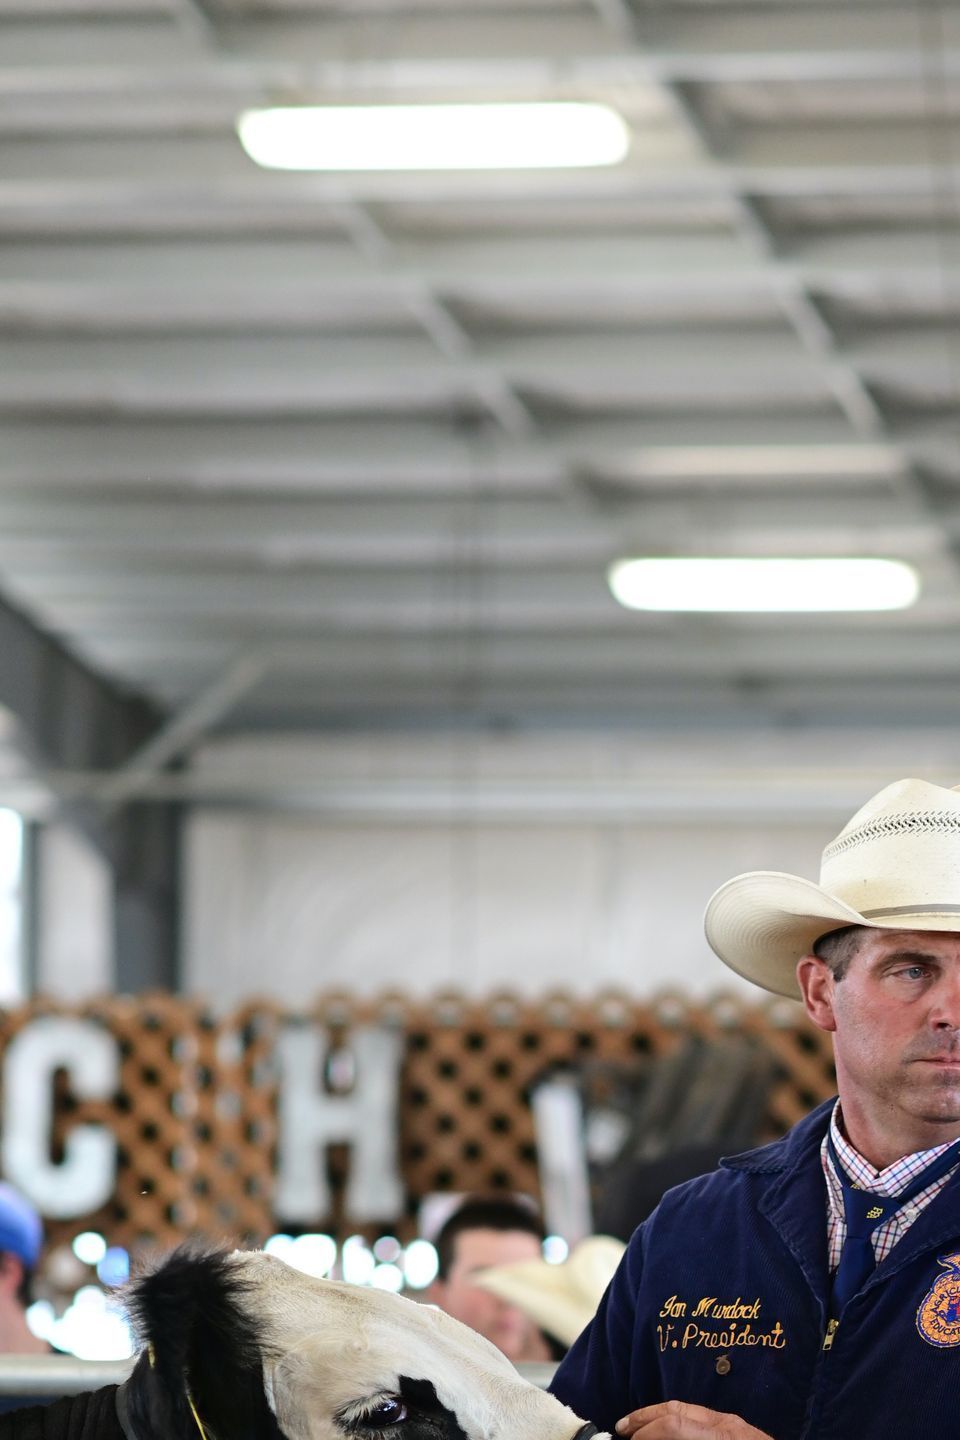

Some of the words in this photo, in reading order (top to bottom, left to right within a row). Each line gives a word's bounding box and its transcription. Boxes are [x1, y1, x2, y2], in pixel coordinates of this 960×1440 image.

[659, 1295, 687, 1318] Ian
[691, 1297, 761, 1319] Murdock
[682, 1321, 786, 1349] President
